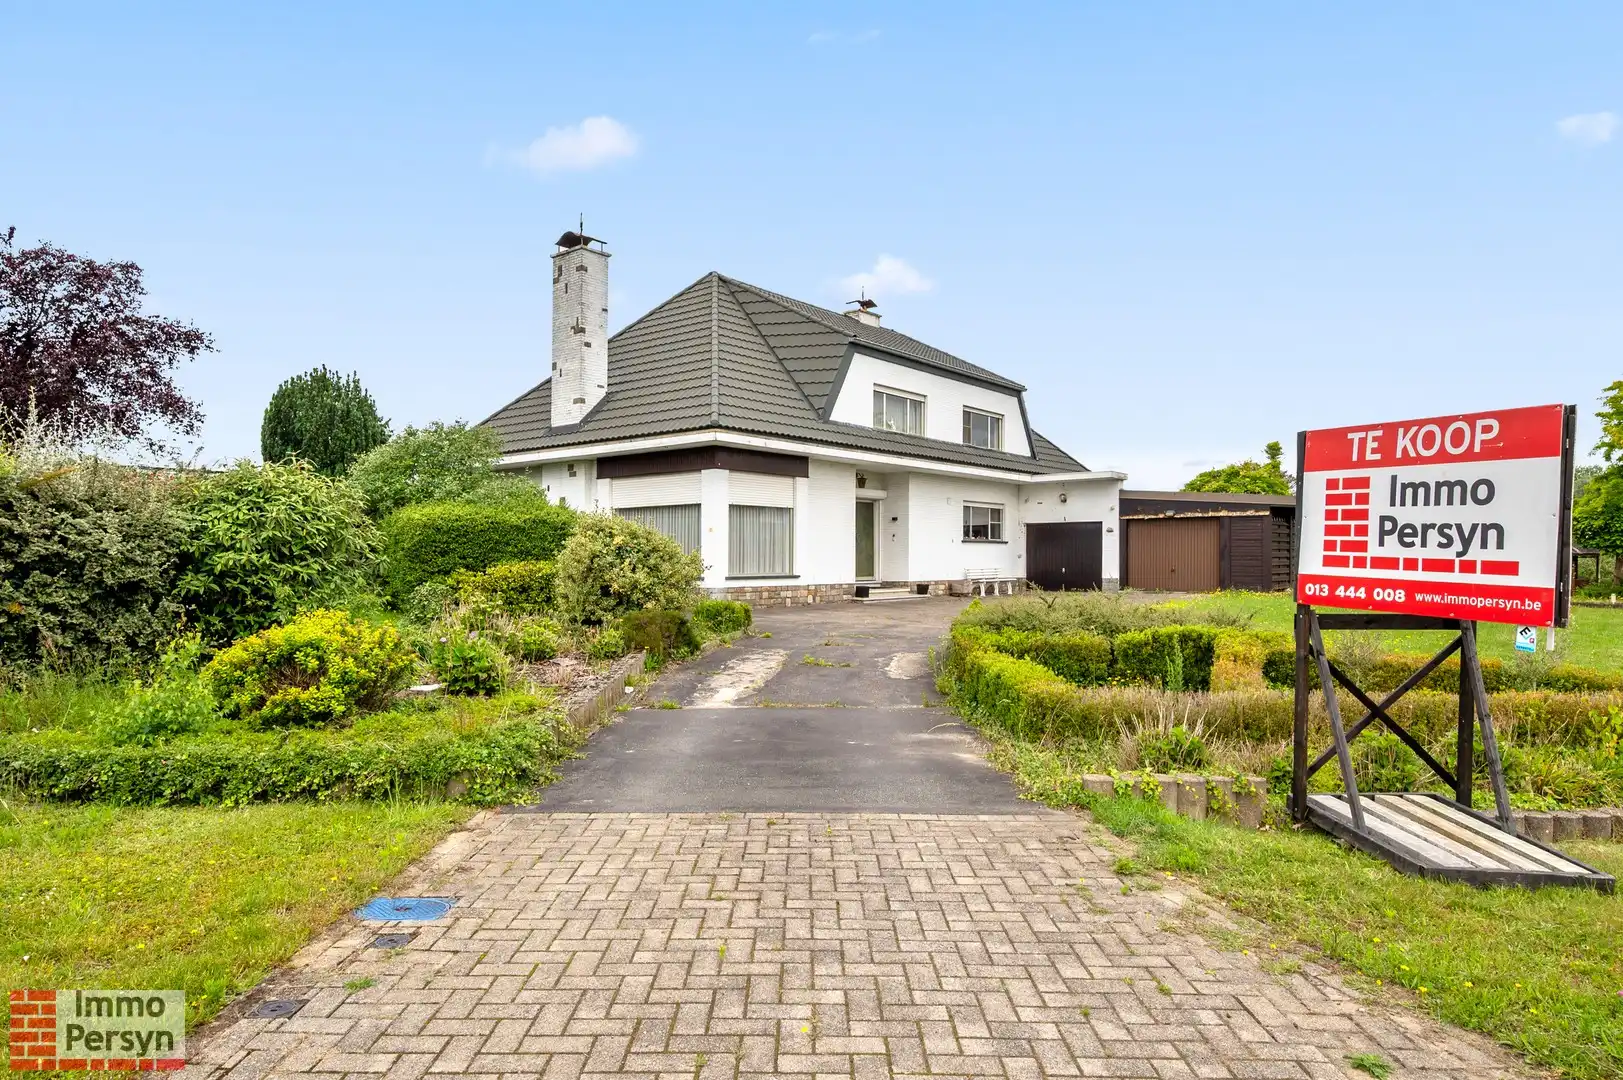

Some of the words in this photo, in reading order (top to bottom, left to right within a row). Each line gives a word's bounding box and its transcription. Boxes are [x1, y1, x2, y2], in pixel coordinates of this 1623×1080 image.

[1347, 430, 1383, 462] TE
[1396, 418, 1500, 459] KOOP
[1389, 474, 1496, 507] Immo
[1378, 515, 1505, 558] Persyn
[1305, 583, 1329, 597] 013
[1335, 585, 1366, 600] 444
[1373, 588, 1406, 603] 008
[1415, 592, 1542, 611] www.immopersyn.be
